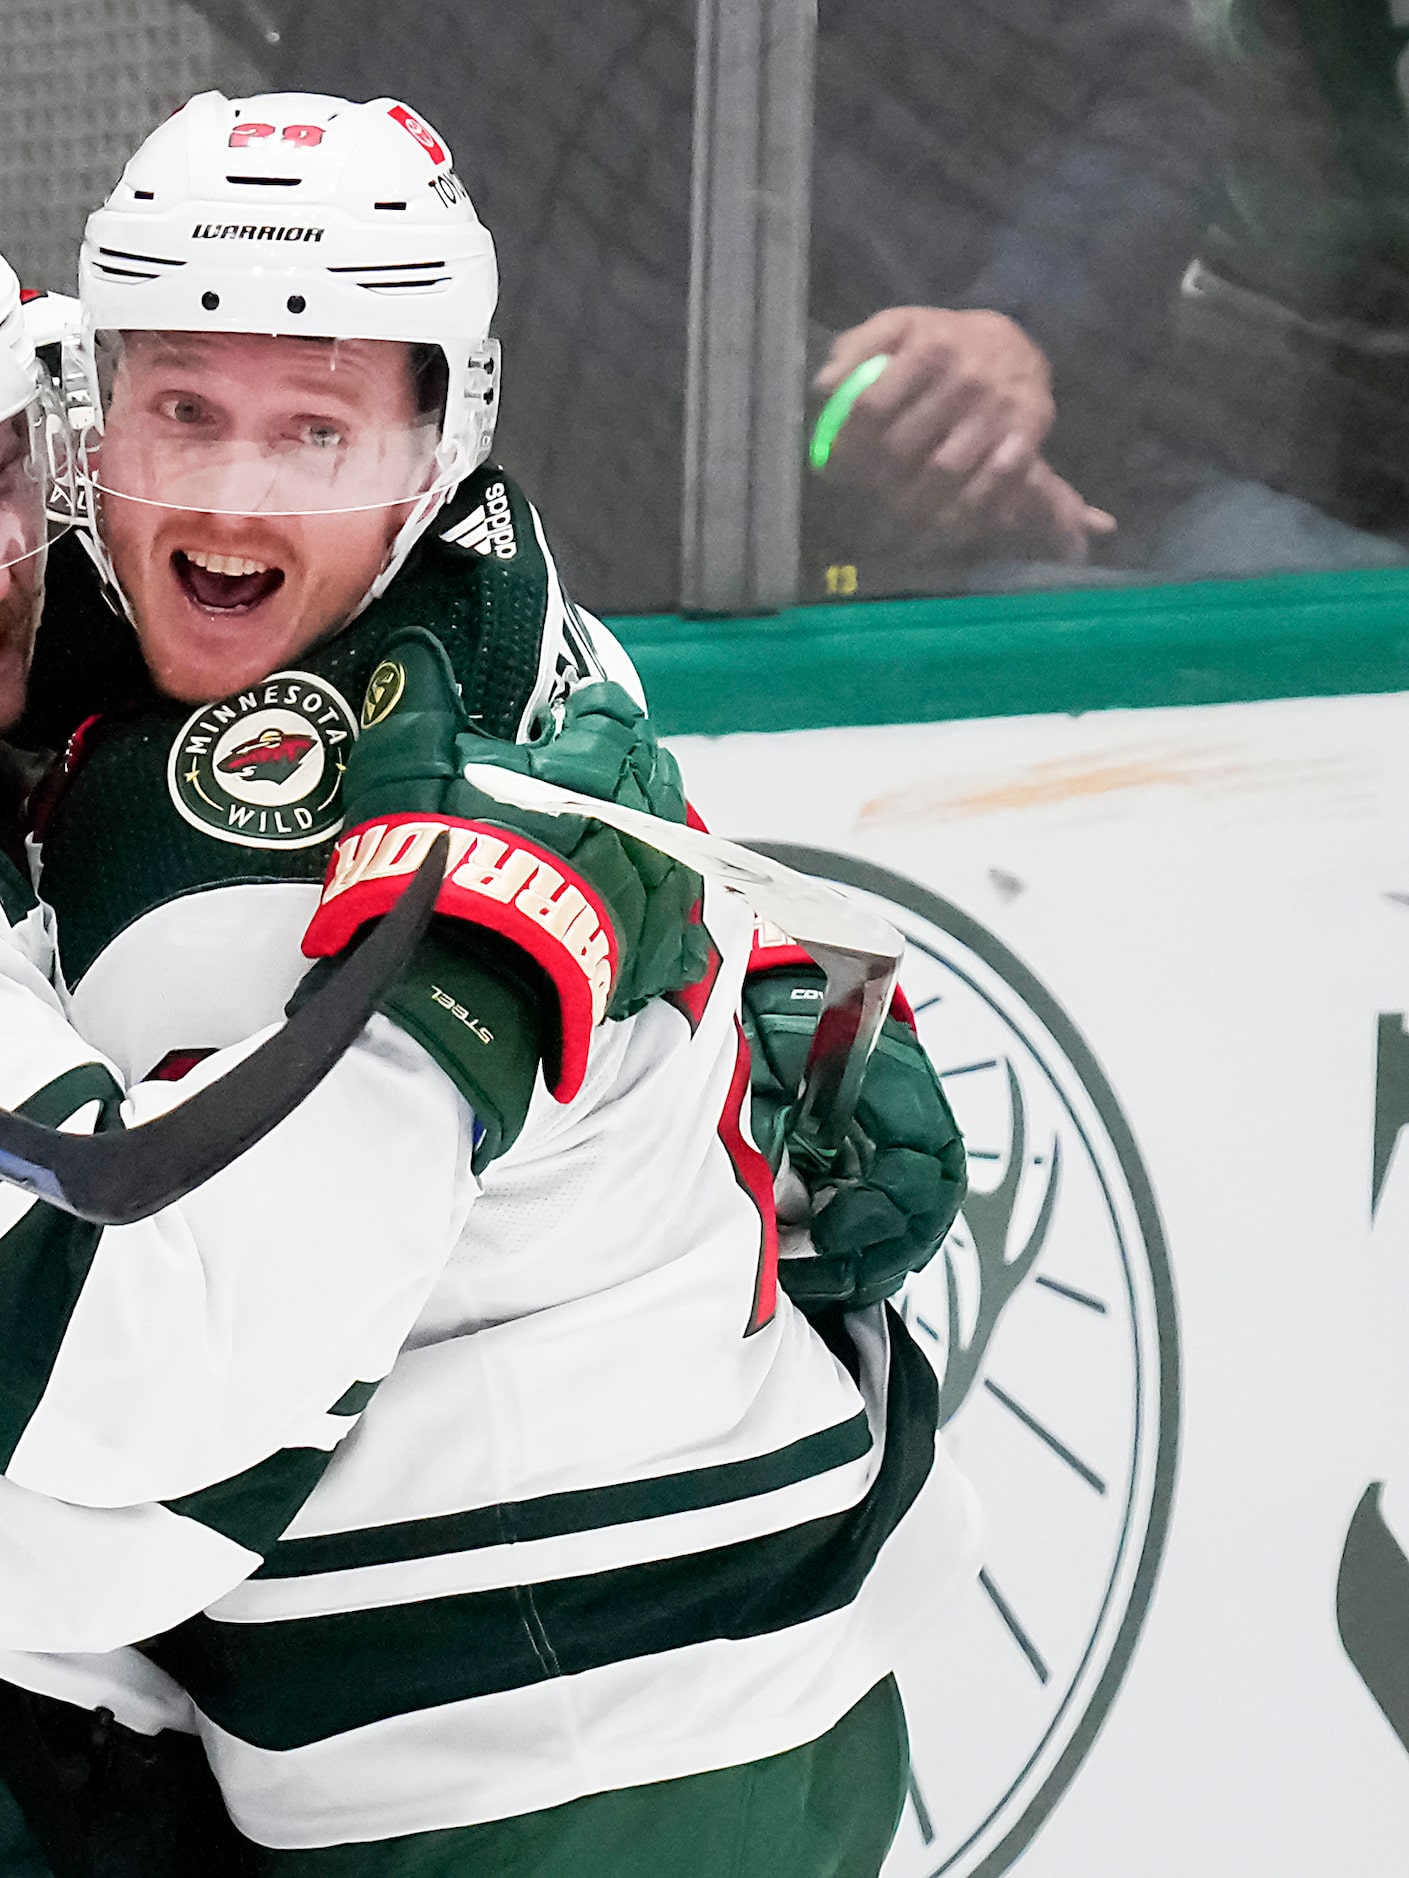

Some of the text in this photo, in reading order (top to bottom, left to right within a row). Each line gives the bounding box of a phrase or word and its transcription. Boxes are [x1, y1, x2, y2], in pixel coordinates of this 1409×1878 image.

[192, 224, 325, 242] WARRIOR
[485, 482, 518, 560] adidas
[186, 685, 348, 754] MINNESOTA
[228, 803, 313, 833] WILD
[430, 984, 495, 1045] STEEL
